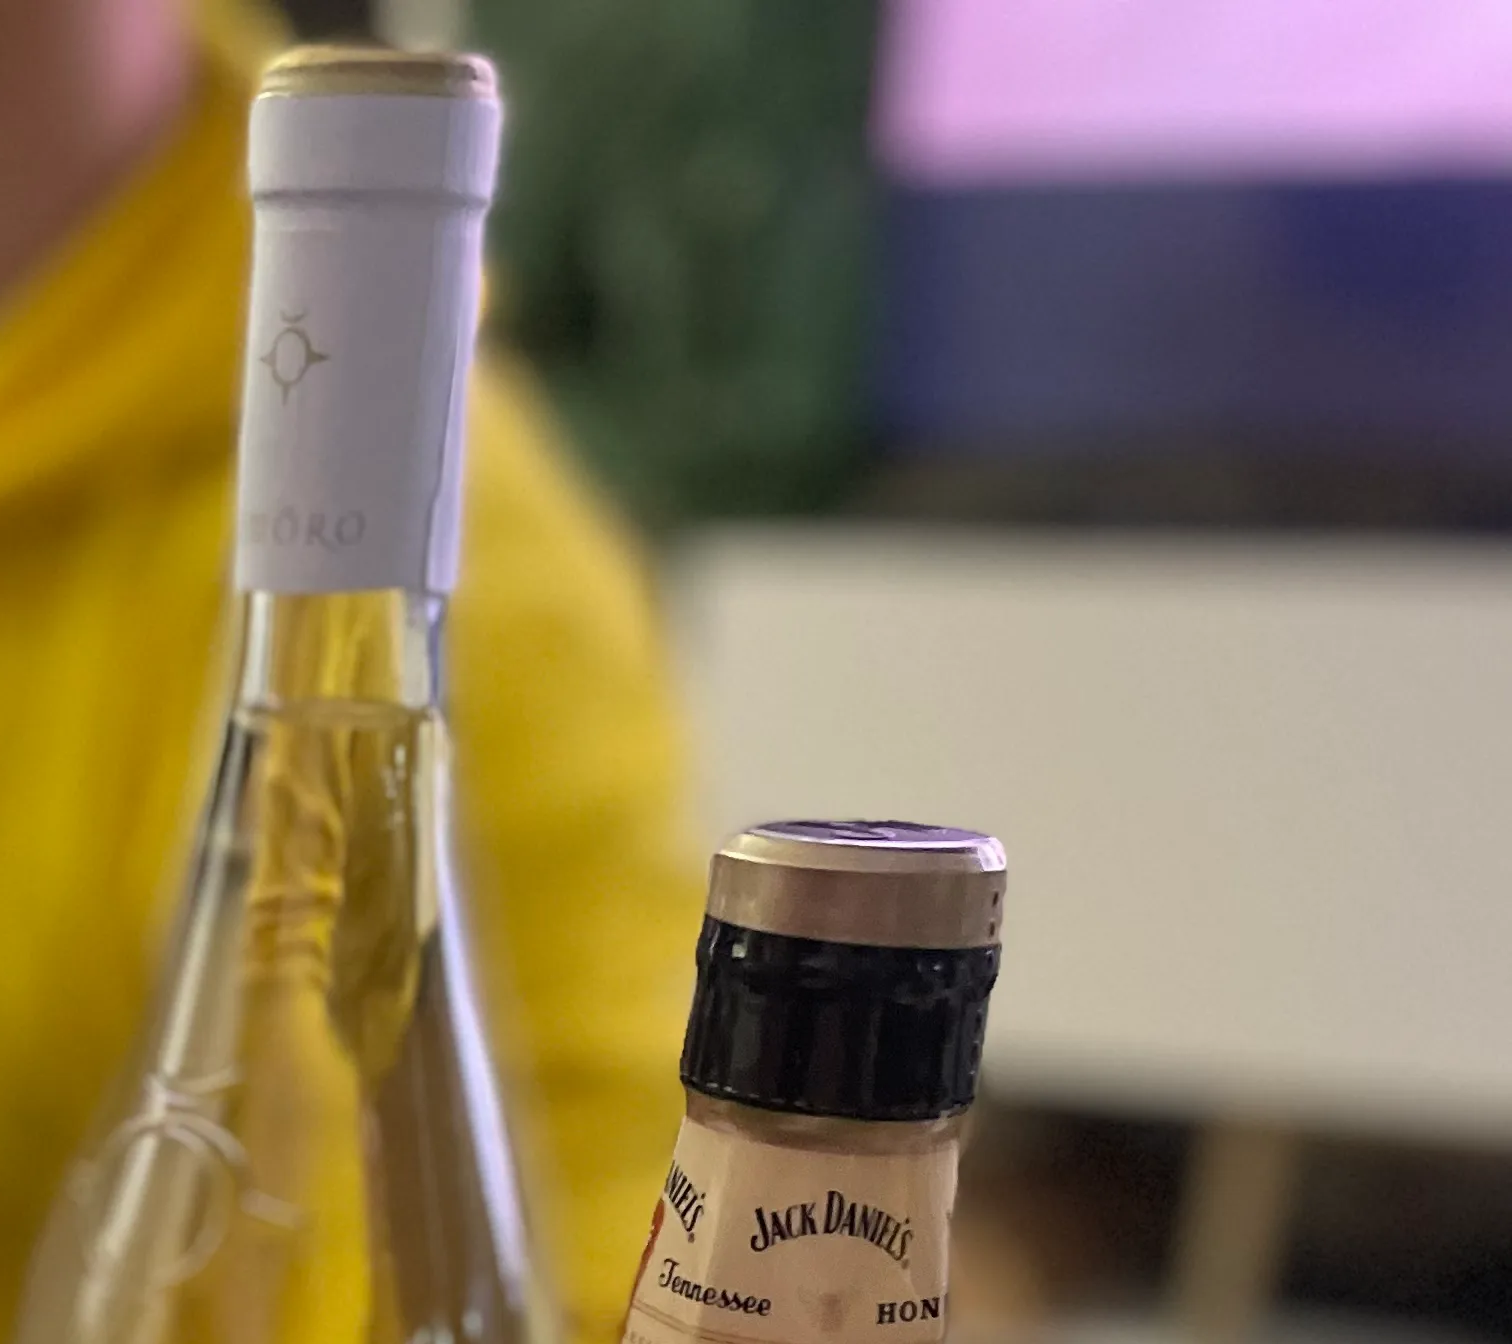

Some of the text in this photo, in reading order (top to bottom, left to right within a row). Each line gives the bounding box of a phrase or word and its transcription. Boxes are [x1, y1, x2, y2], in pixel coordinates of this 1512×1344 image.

[750, 1189, 915, 1263] JACK DANIEL'S
[657, 1257, 773, 1318] Tennessee
